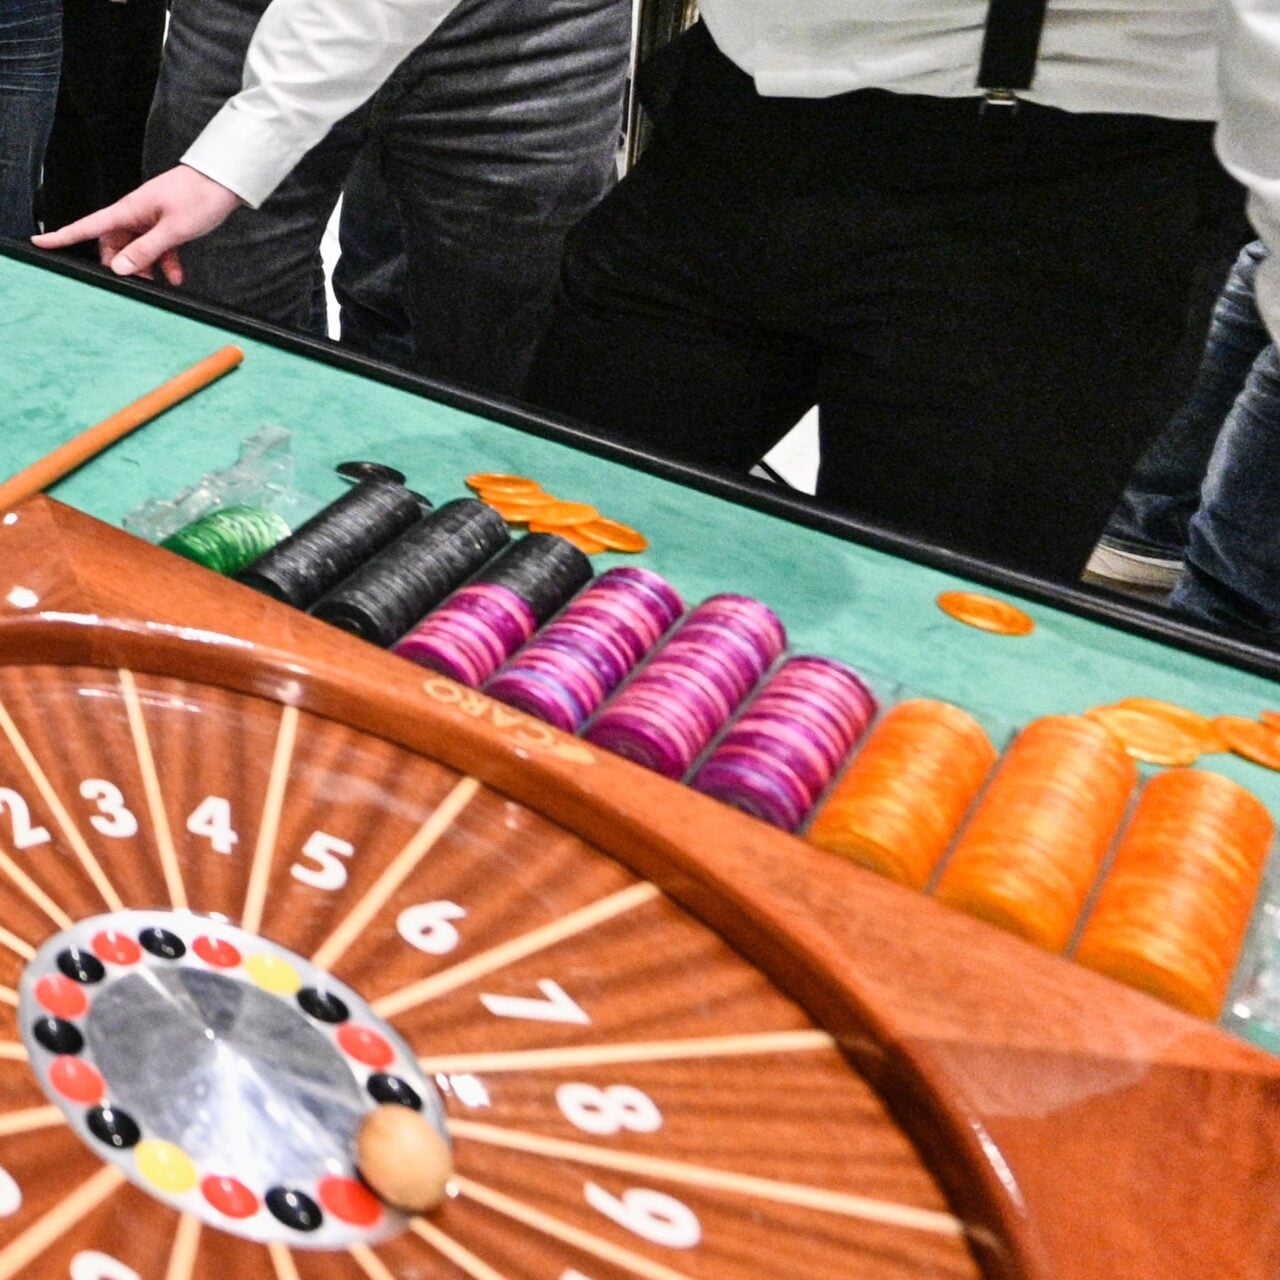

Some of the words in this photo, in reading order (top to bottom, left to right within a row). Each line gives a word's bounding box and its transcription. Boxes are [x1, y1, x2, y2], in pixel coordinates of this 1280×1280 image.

[79, 779, 138, 837] 3
[187, 796, 238, 854] 4
[290, 831, 354, 890] 5
[479, 979, 592, 1025] 7
[555, 1083, 662, 1135] 8
